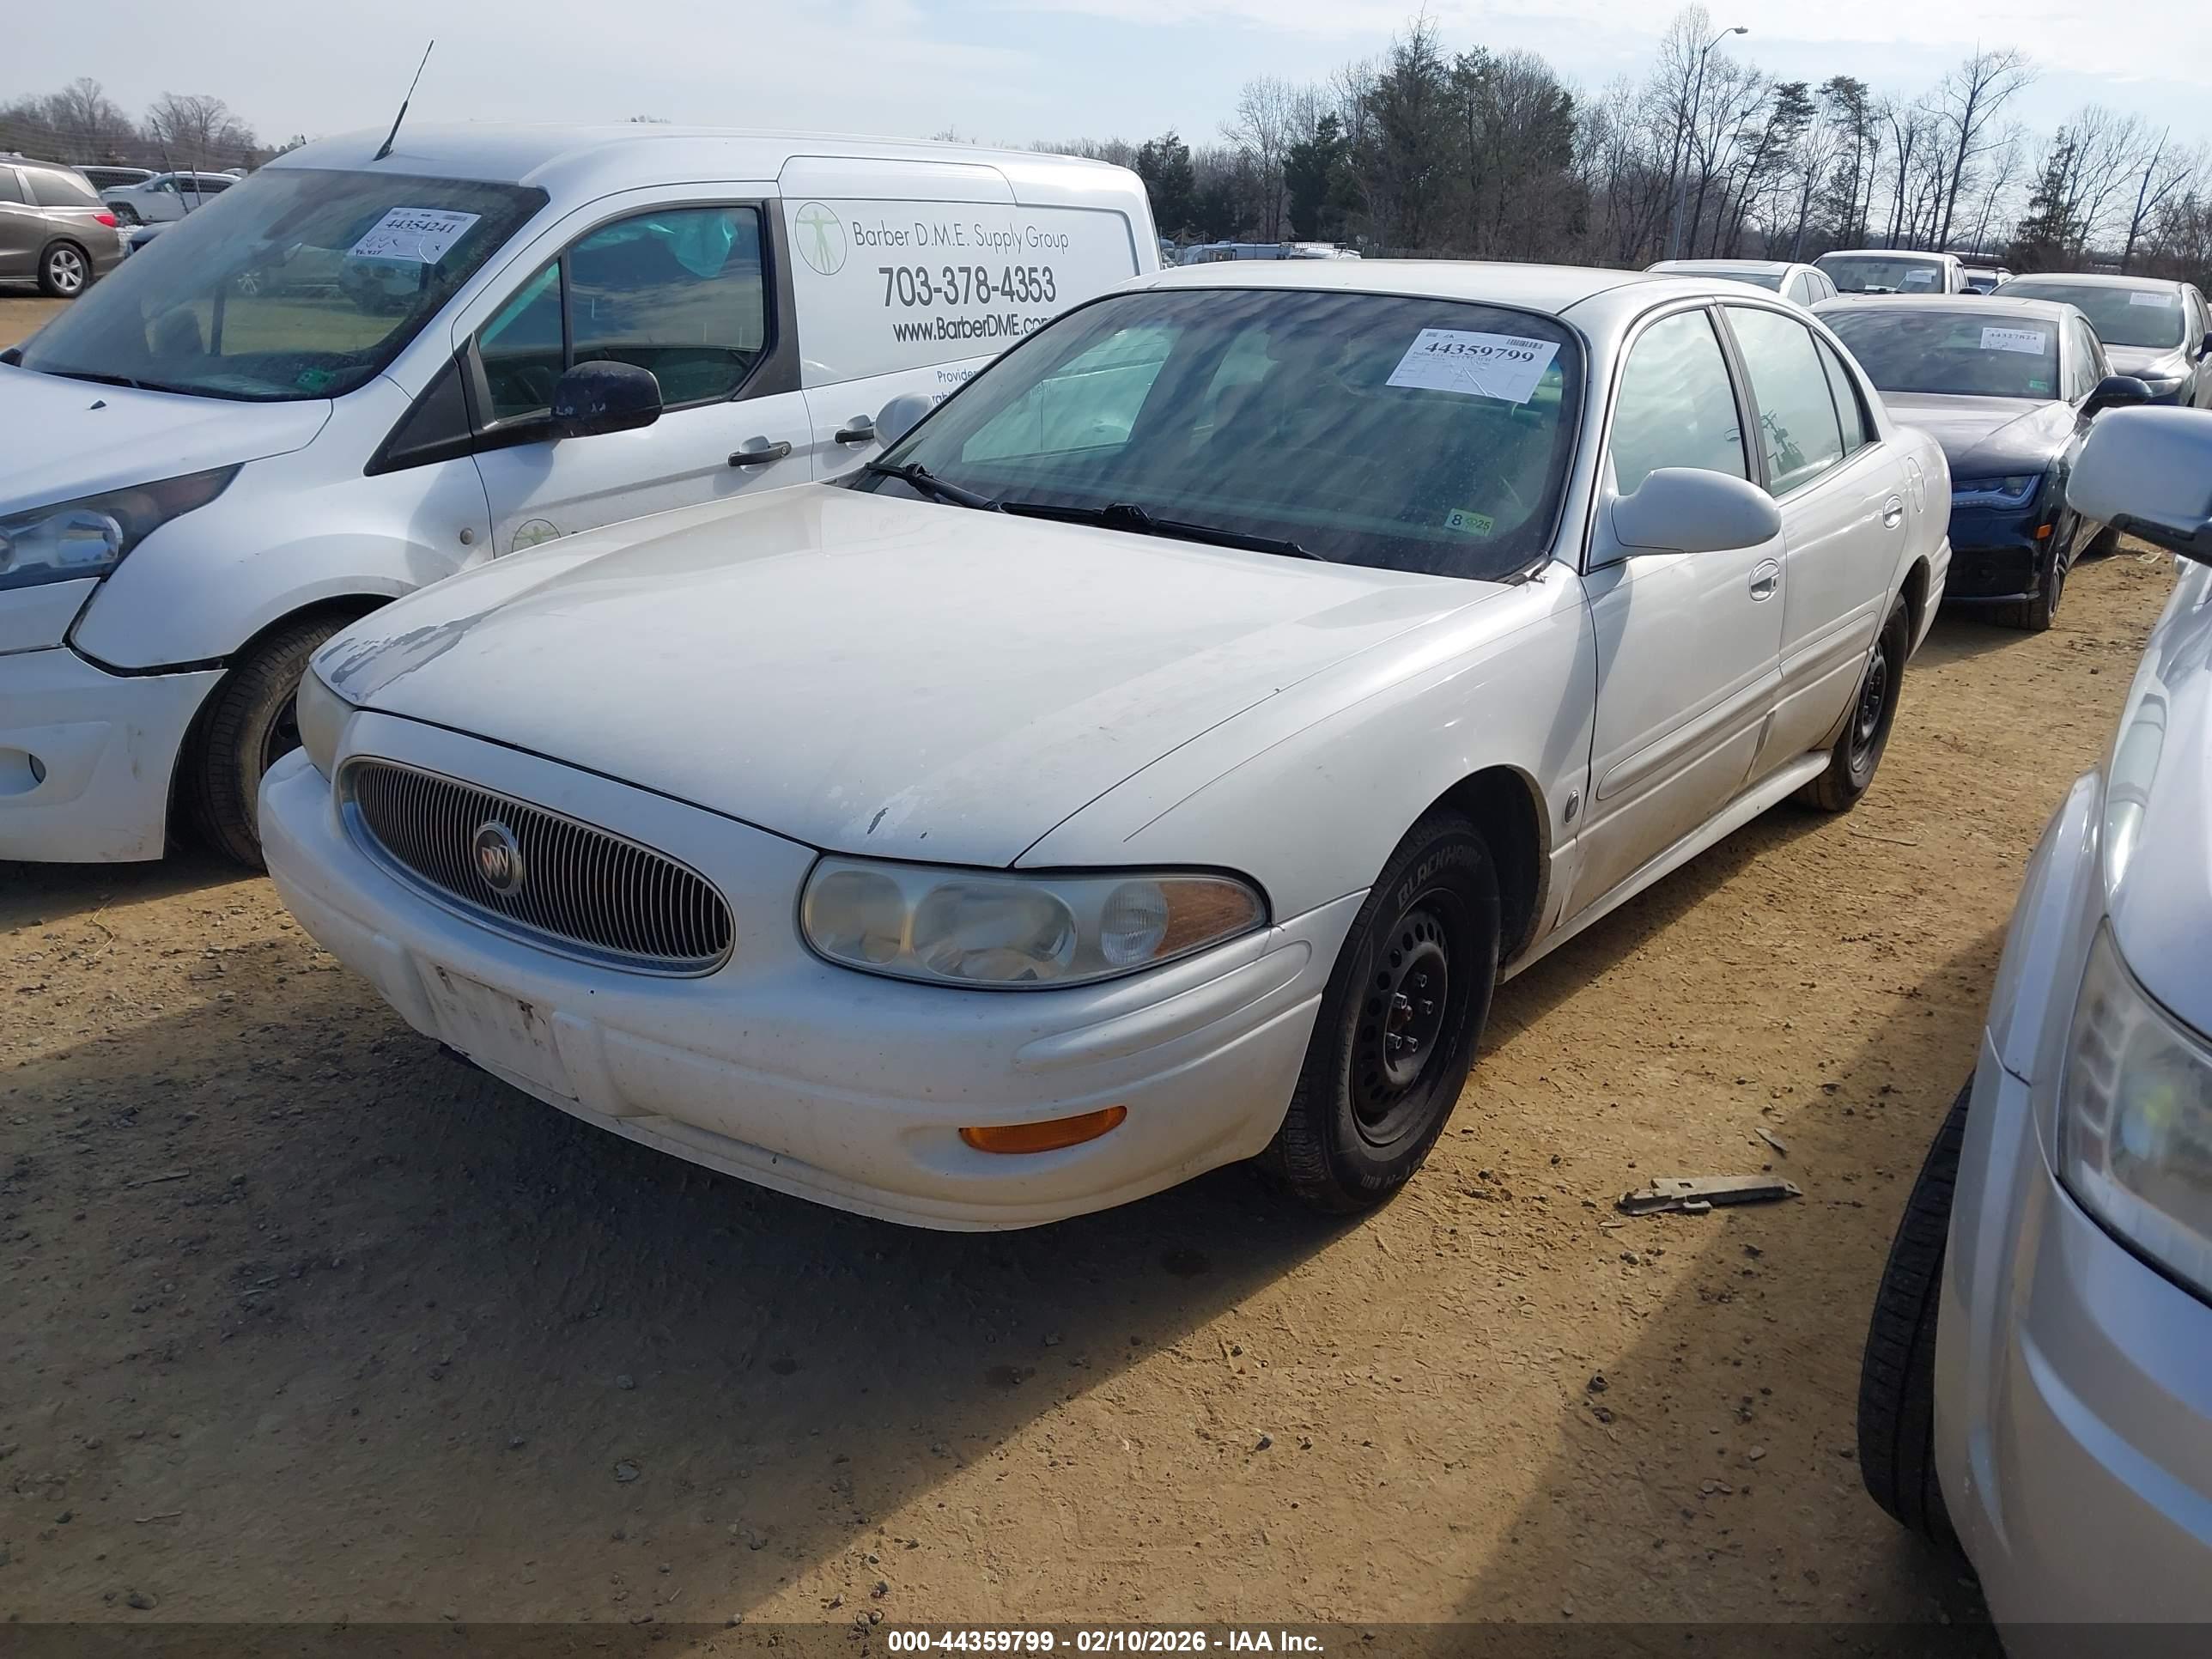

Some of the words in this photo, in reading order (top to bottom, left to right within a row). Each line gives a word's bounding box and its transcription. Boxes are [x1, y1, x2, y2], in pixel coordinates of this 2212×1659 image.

[853, 220, 909, 246] Barber
[974, 223, 1022, 254] Supply
[1026, 226, 1069, 254] Group
[878, 266, 1056, 307] 703-378-4353
[1425, 343, 1535, 363] 44359799
[1451, 514, 1463, 526] 8
[1475, 519, 1492, 530] 25
